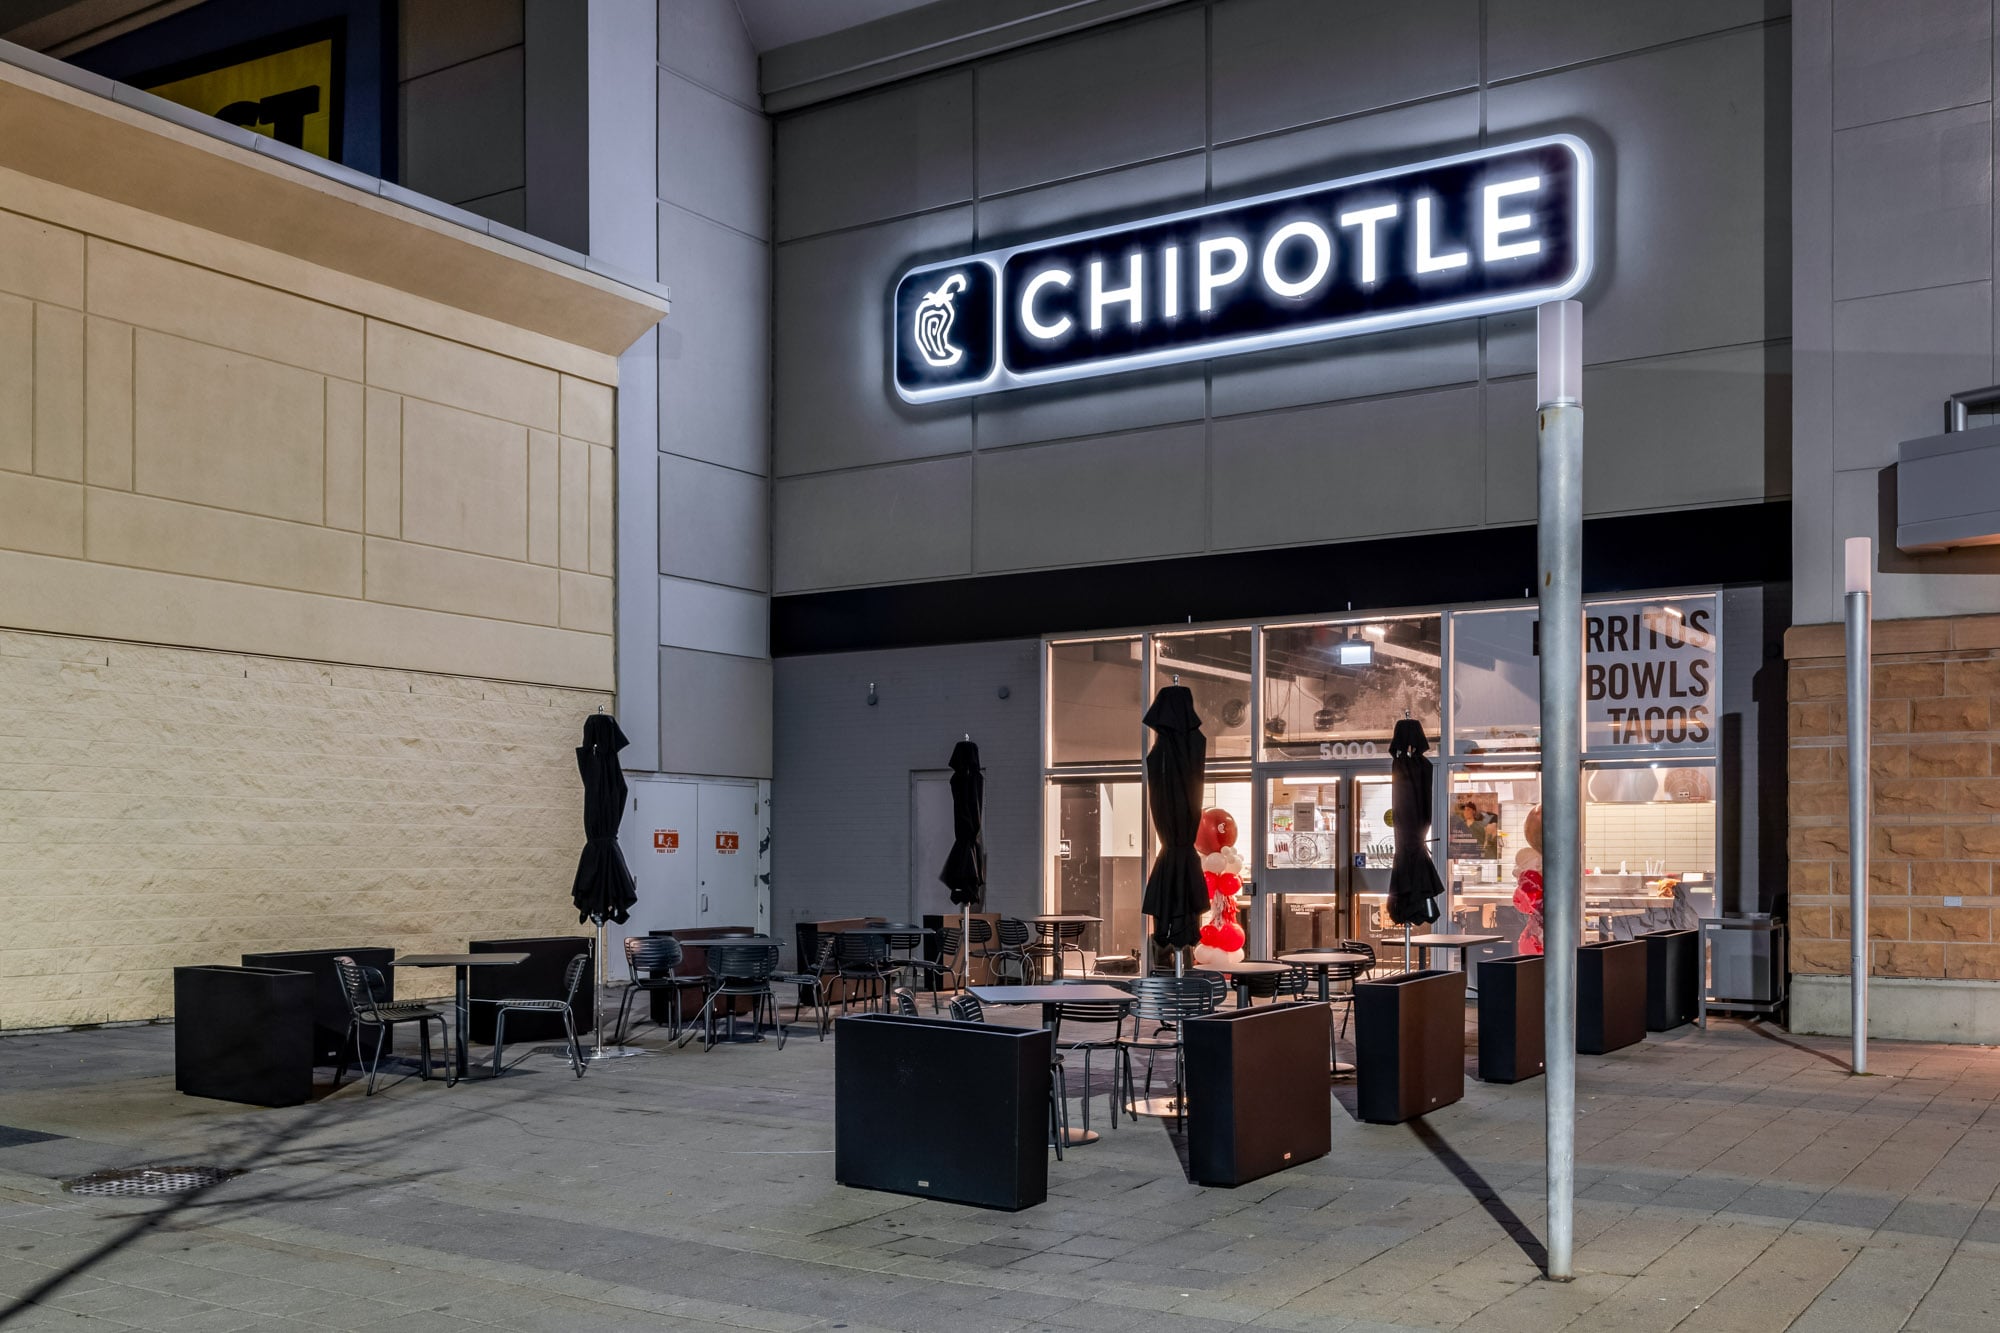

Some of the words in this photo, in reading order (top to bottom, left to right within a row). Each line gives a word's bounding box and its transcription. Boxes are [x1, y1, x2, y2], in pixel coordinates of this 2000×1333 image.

[1020, 176, 1541, 340] CHIPOTLE
[1533, 609, 1710, 656] RRITOS
[1586, 659, 1710, 701] BOWLS
[1607, 704, 1710, 745] TACOS
[1320, 741, 1377, 760] 5000
